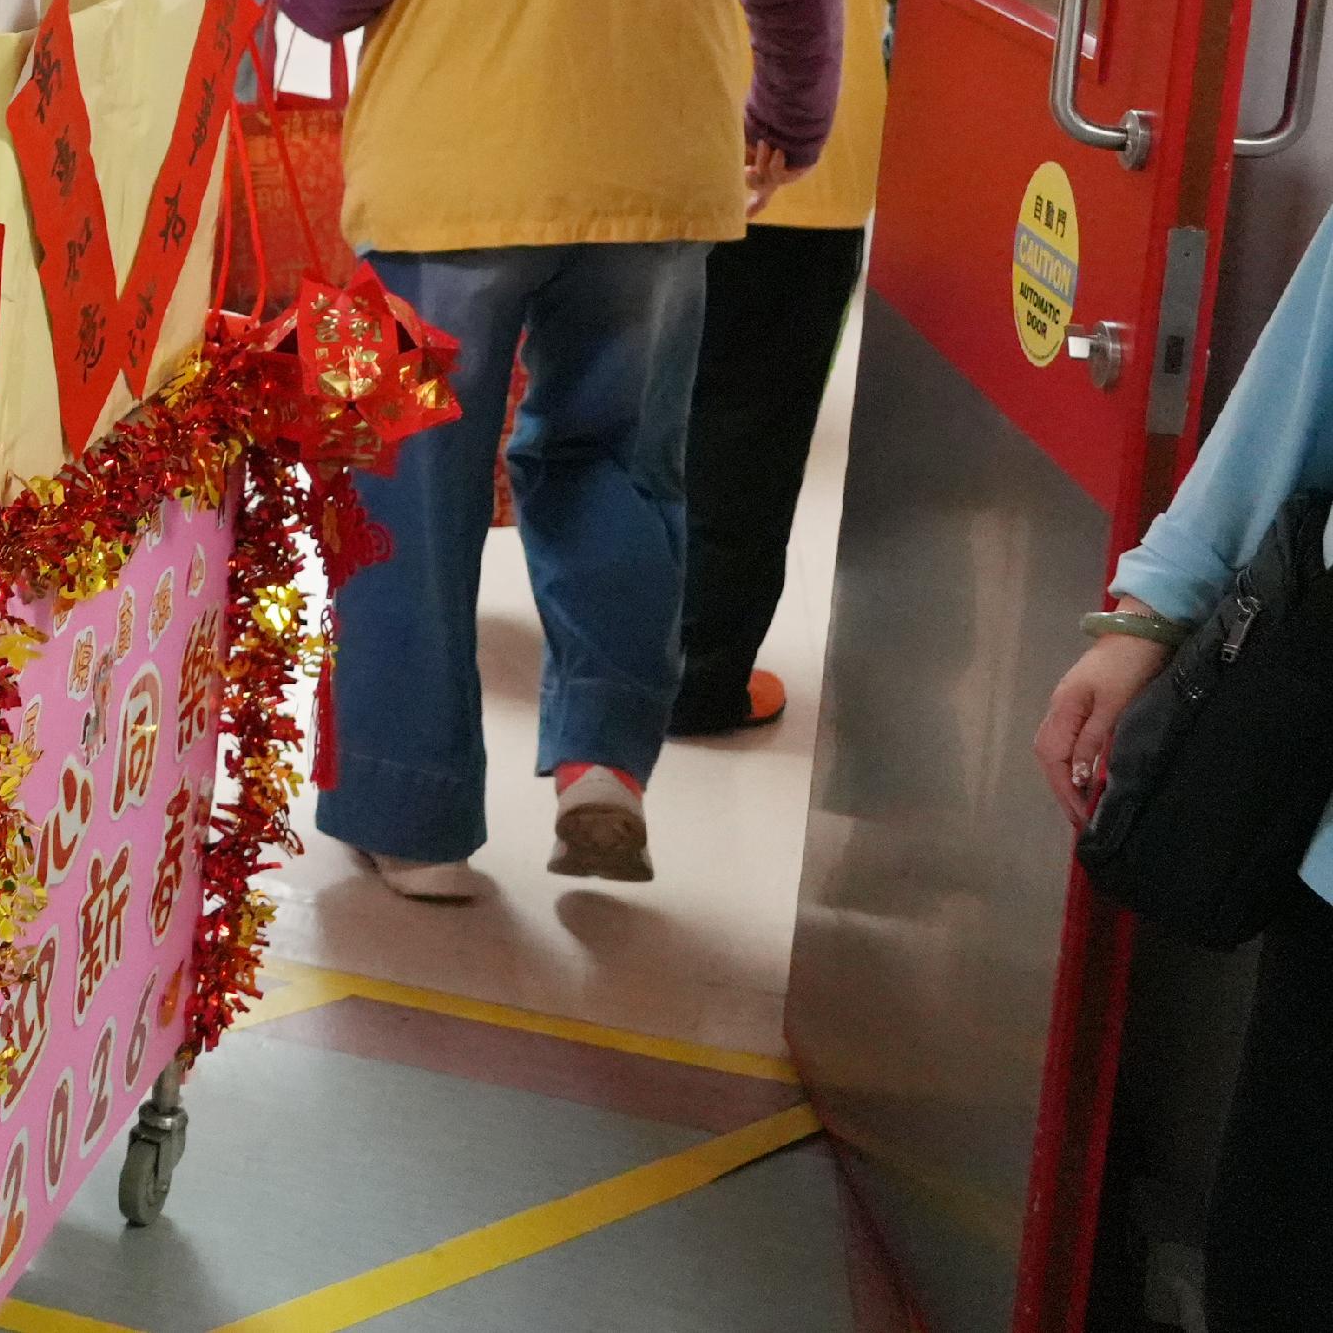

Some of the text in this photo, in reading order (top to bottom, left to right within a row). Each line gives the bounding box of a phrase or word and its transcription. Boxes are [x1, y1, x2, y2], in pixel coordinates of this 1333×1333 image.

[1033, 193, 1068, 239] 自動門
[1018, 232, 1072, 297] CAUTION
[1020, 281, 1061, 326] AUTOMATIC
[1026, 309, 1049, 340] DOOR
[0, 972, 157, 1269] 2026
